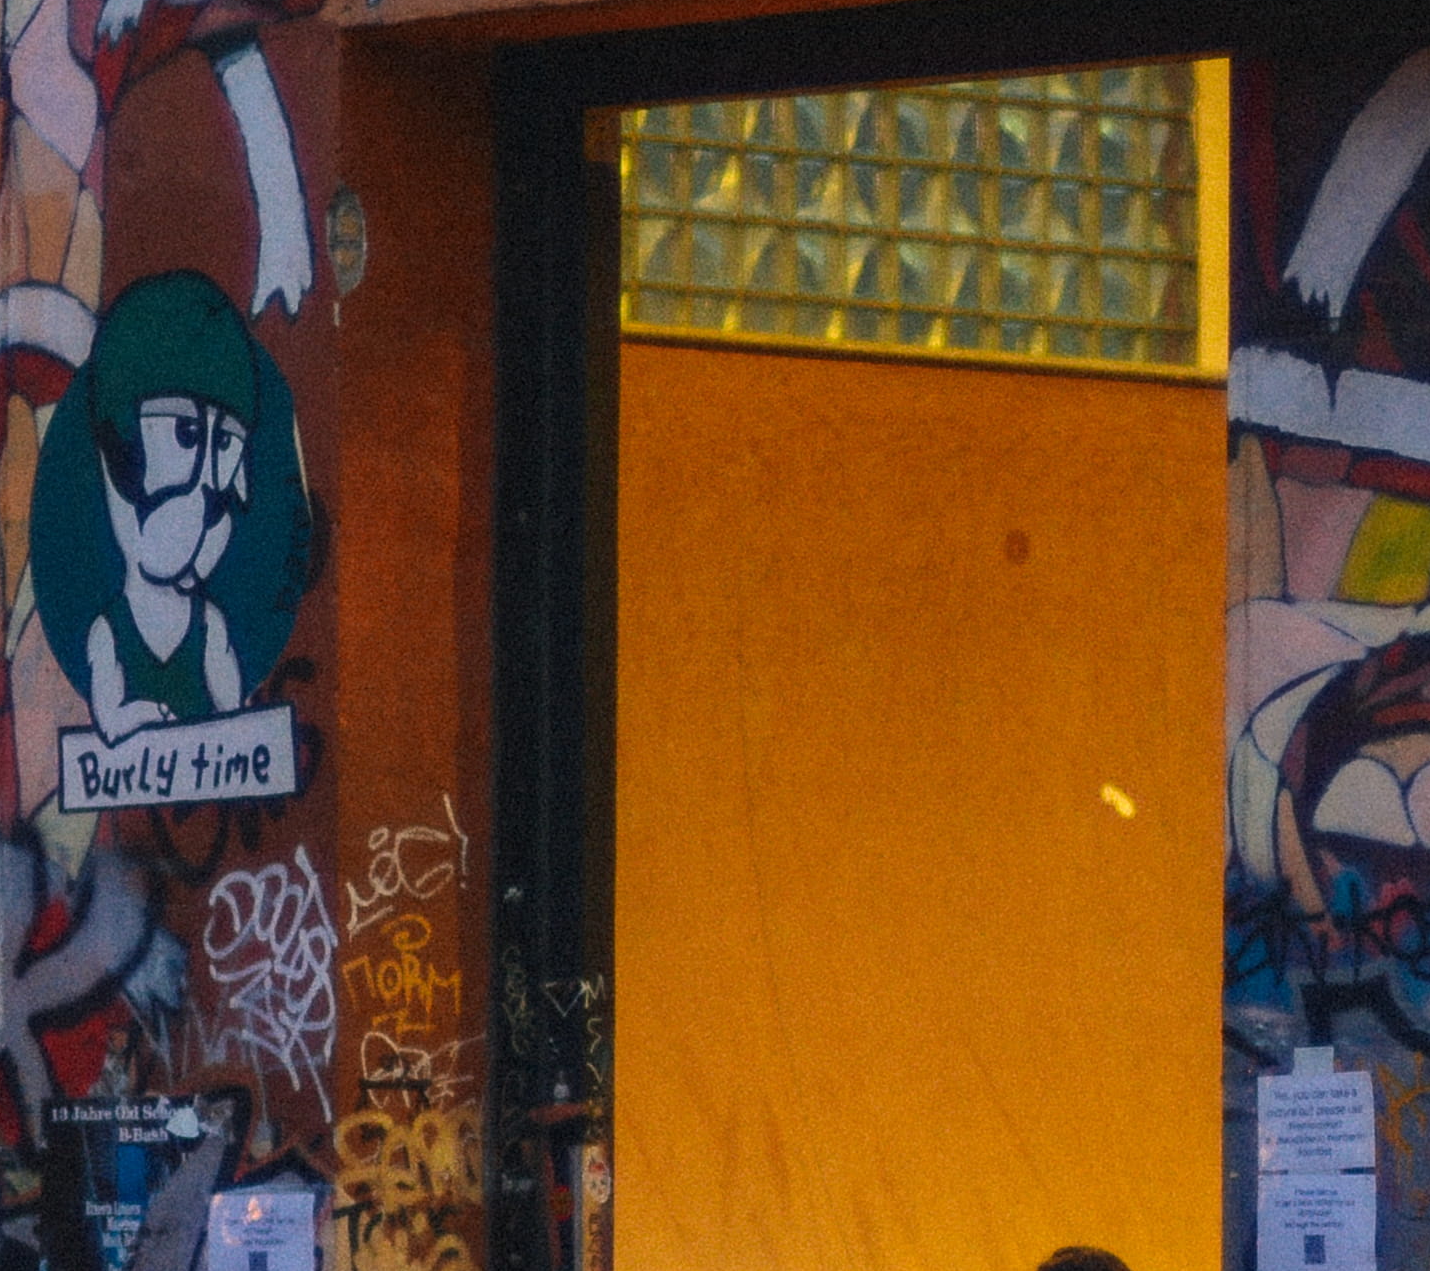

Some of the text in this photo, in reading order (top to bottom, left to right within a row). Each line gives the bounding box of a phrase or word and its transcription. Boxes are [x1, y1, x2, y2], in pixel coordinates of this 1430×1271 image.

[78, 740, 271, 798] Burly time
[71, 1106, 112, 1121] Jahre
